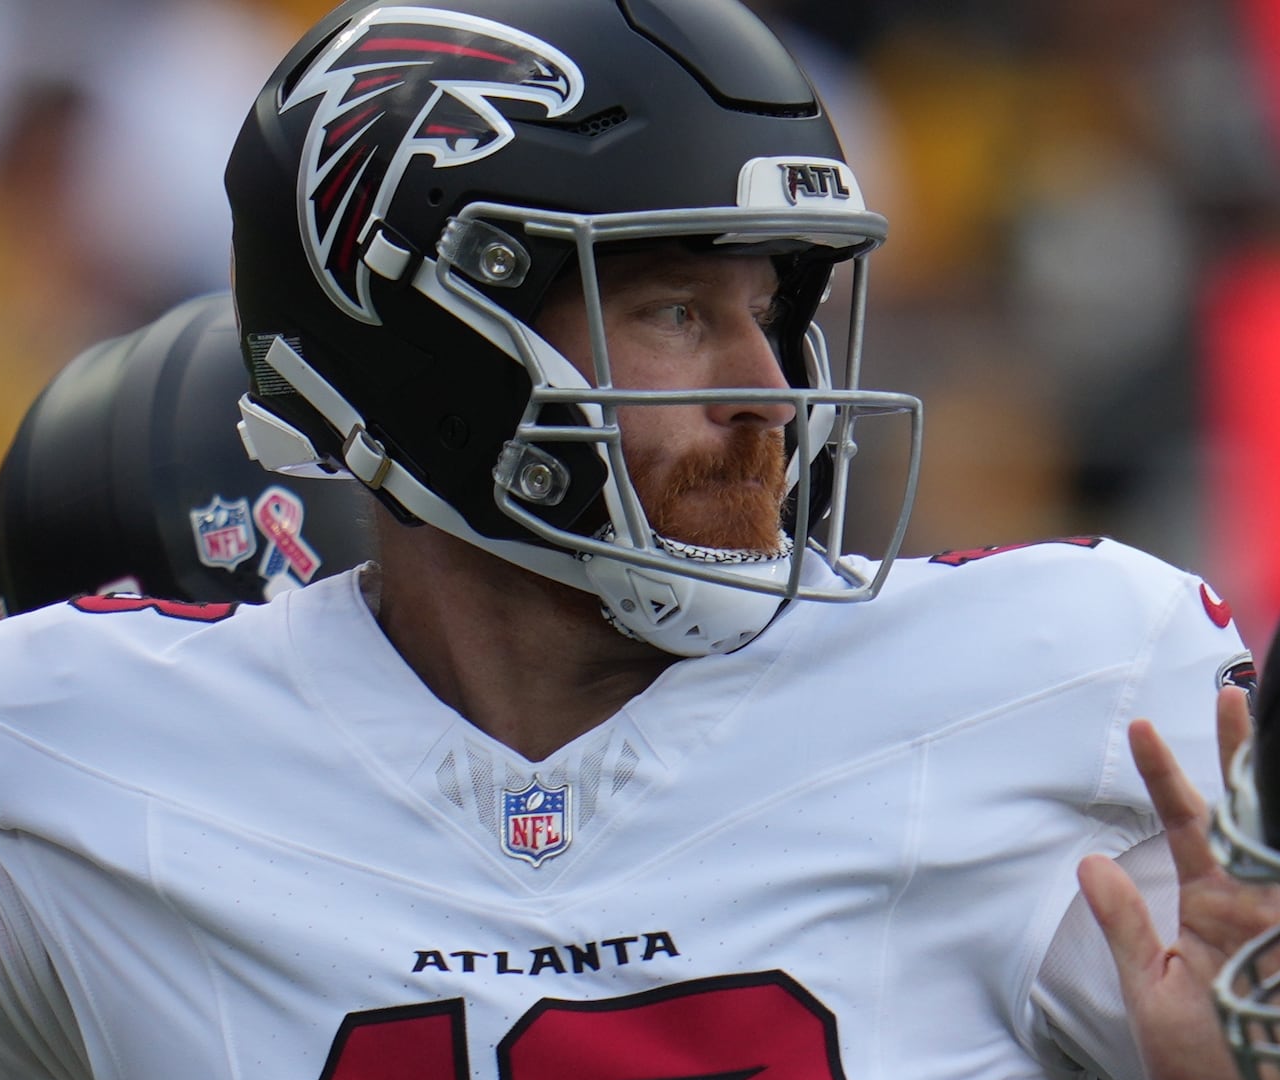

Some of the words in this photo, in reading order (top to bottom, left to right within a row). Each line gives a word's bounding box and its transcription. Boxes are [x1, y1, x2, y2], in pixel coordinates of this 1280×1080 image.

[777, 163, 850, 206] ATL
[206, 527, 249, 559] NFL
[511, 815, 560, 850] NFL
[412, 931, 681, 976] ATLANTA
